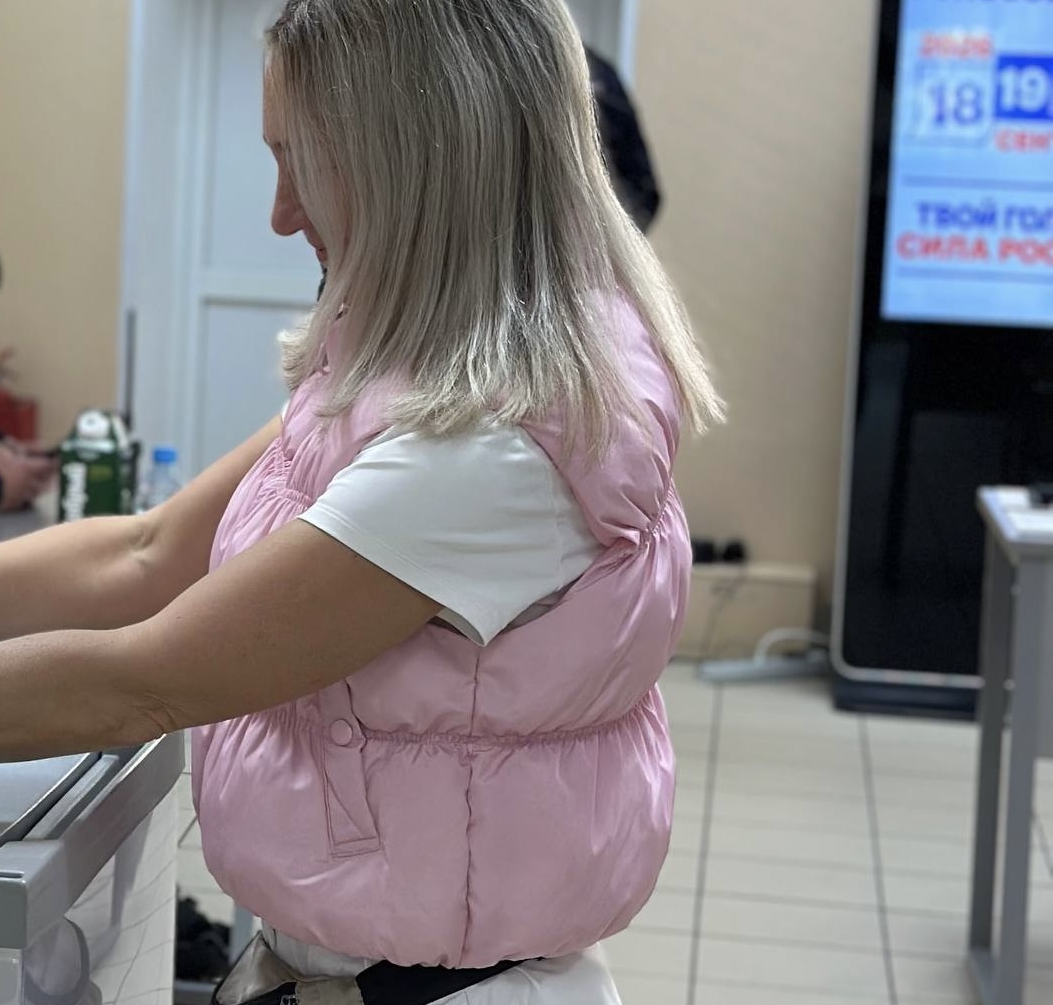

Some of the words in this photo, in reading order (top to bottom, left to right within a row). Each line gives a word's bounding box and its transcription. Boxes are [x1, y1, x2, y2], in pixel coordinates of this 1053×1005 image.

[930, 81, 983, 128] 18
[999, 64, 1047, 114] 19
[917, 198, 996, 231] ТВОЙ
[897, 229, 989, 263] СИЛА
